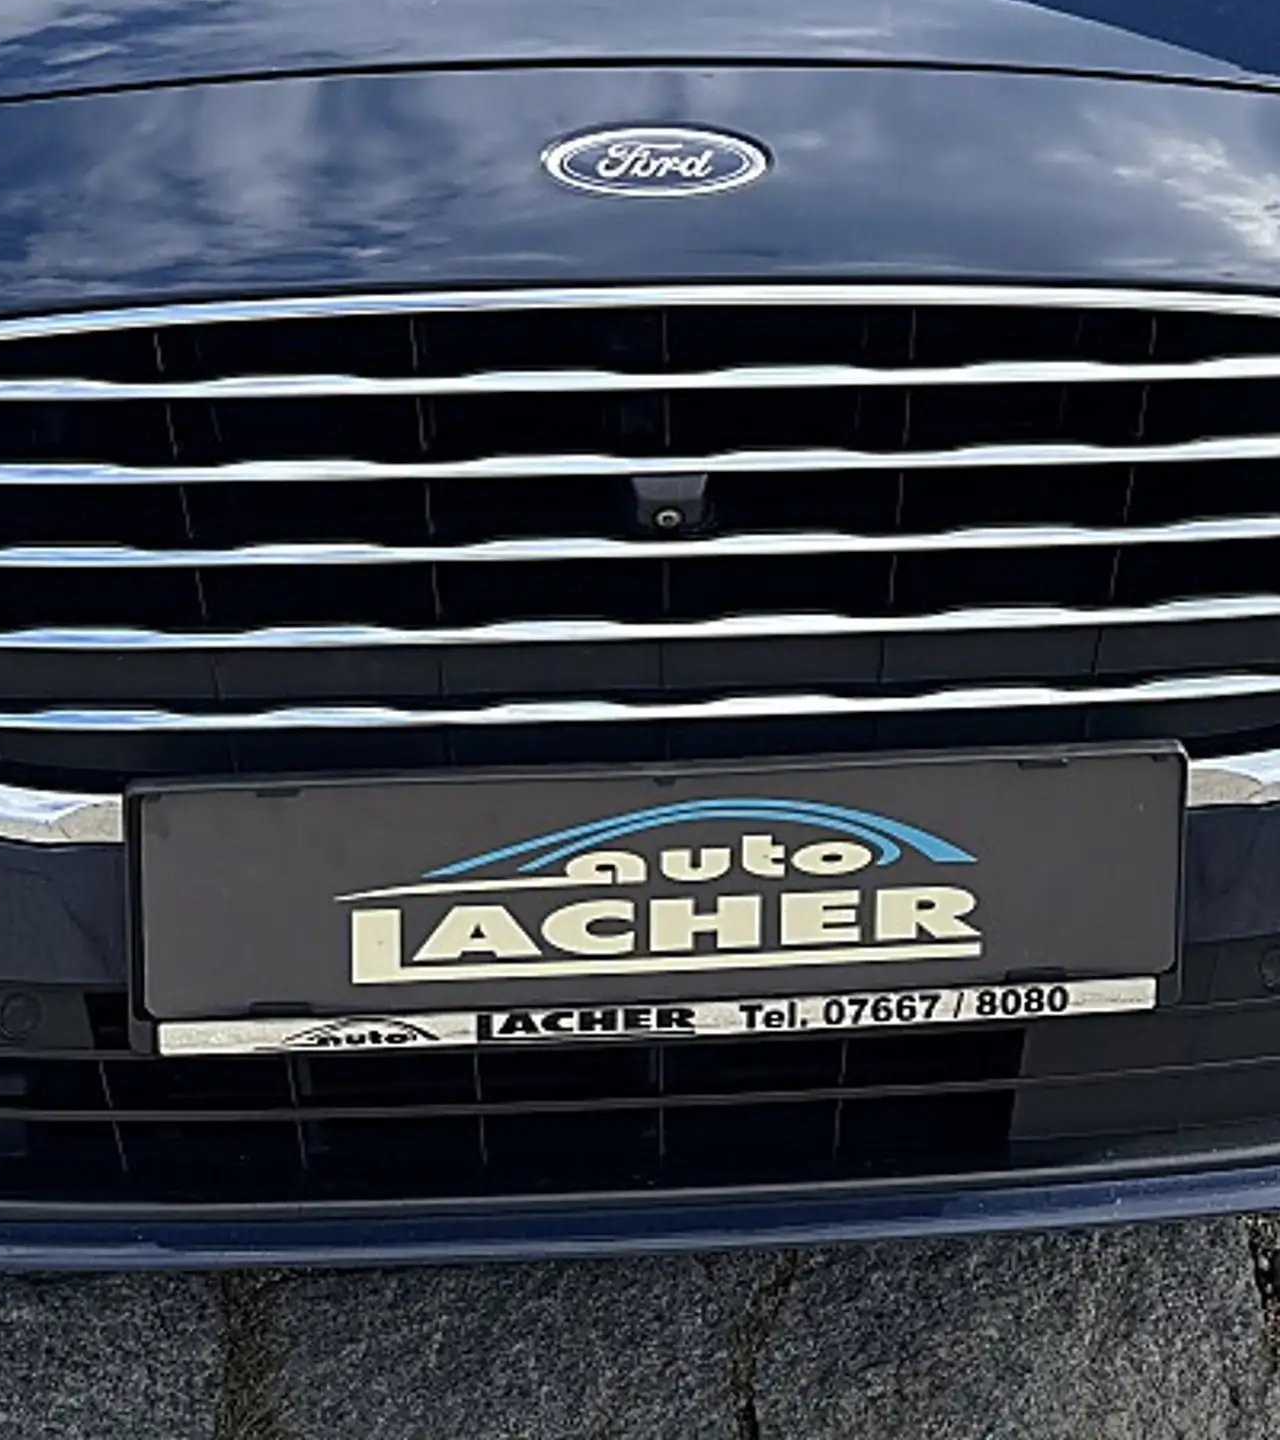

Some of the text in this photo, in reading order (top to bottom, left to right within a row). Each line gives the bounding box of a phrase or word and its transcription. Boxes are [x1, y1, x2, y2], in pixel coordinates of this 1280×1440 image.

[595, 140, 715, 179] Ford
[563, 832, 877, 885] auto
[351, 884, 982, 984] LACHER
[476, 1005, 697, 1042] LACHER
[740, 1003, 808, 1030] Tel.
[823, 994, 941, 1025] 07667
[953, 993, 967, 1019] /
[975, 985, 1070, 1016] 8080
